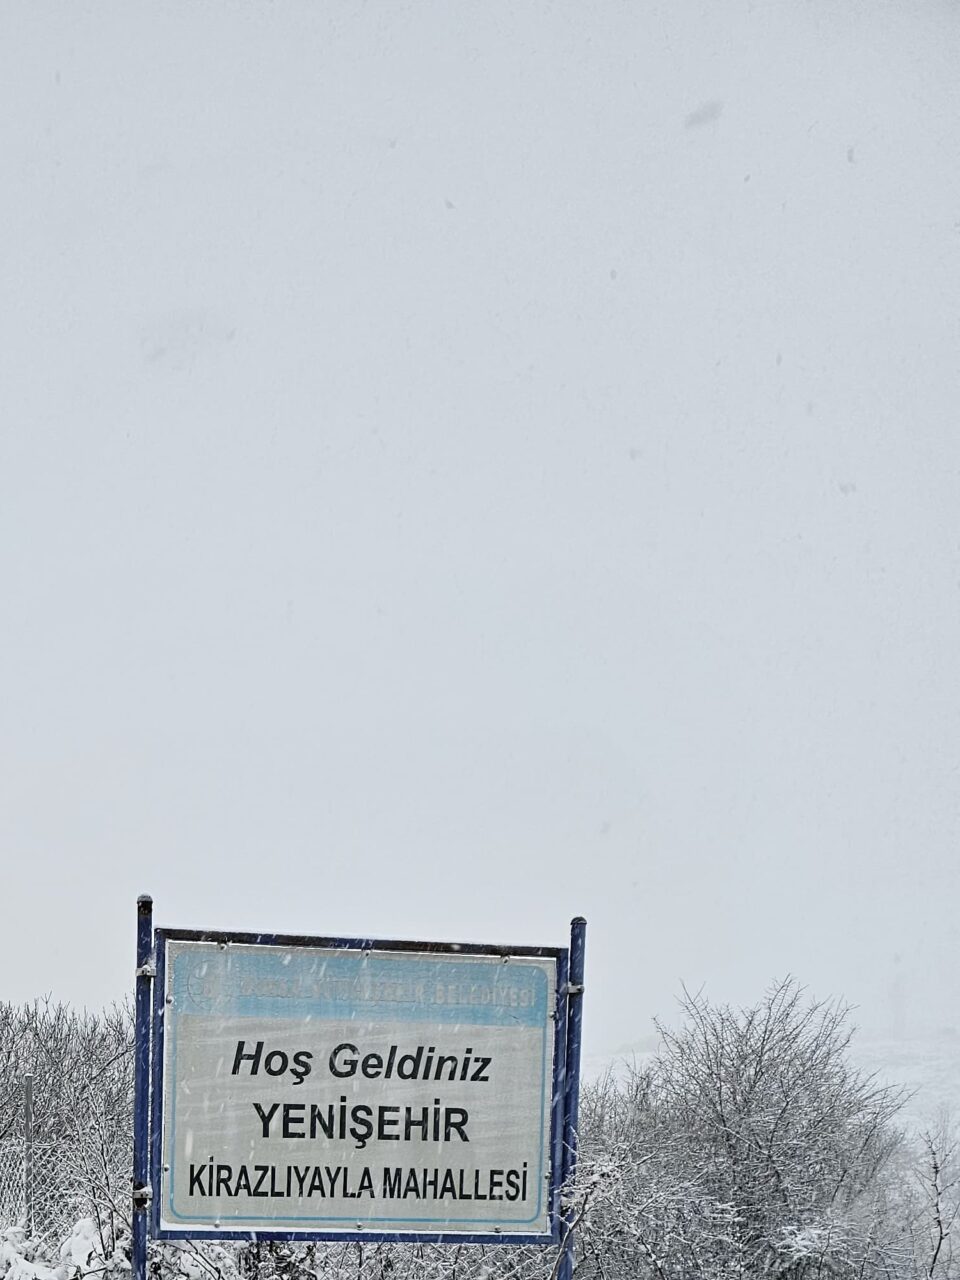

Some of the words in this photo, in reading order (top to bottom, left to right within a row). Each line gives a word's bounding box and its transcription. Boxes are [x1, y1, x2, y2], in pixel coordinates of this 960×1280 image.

[231, 1041, 314, 1086] Hoş
[329, 1043, 493, 1082] Geldiniz
[253, 1096, 471, 1149] YENİŞEHİR
[189, 1156, 376, 1199] KİRAZLIYAYLA
[383, 1162, 529, 1202] MAHALLESİ
